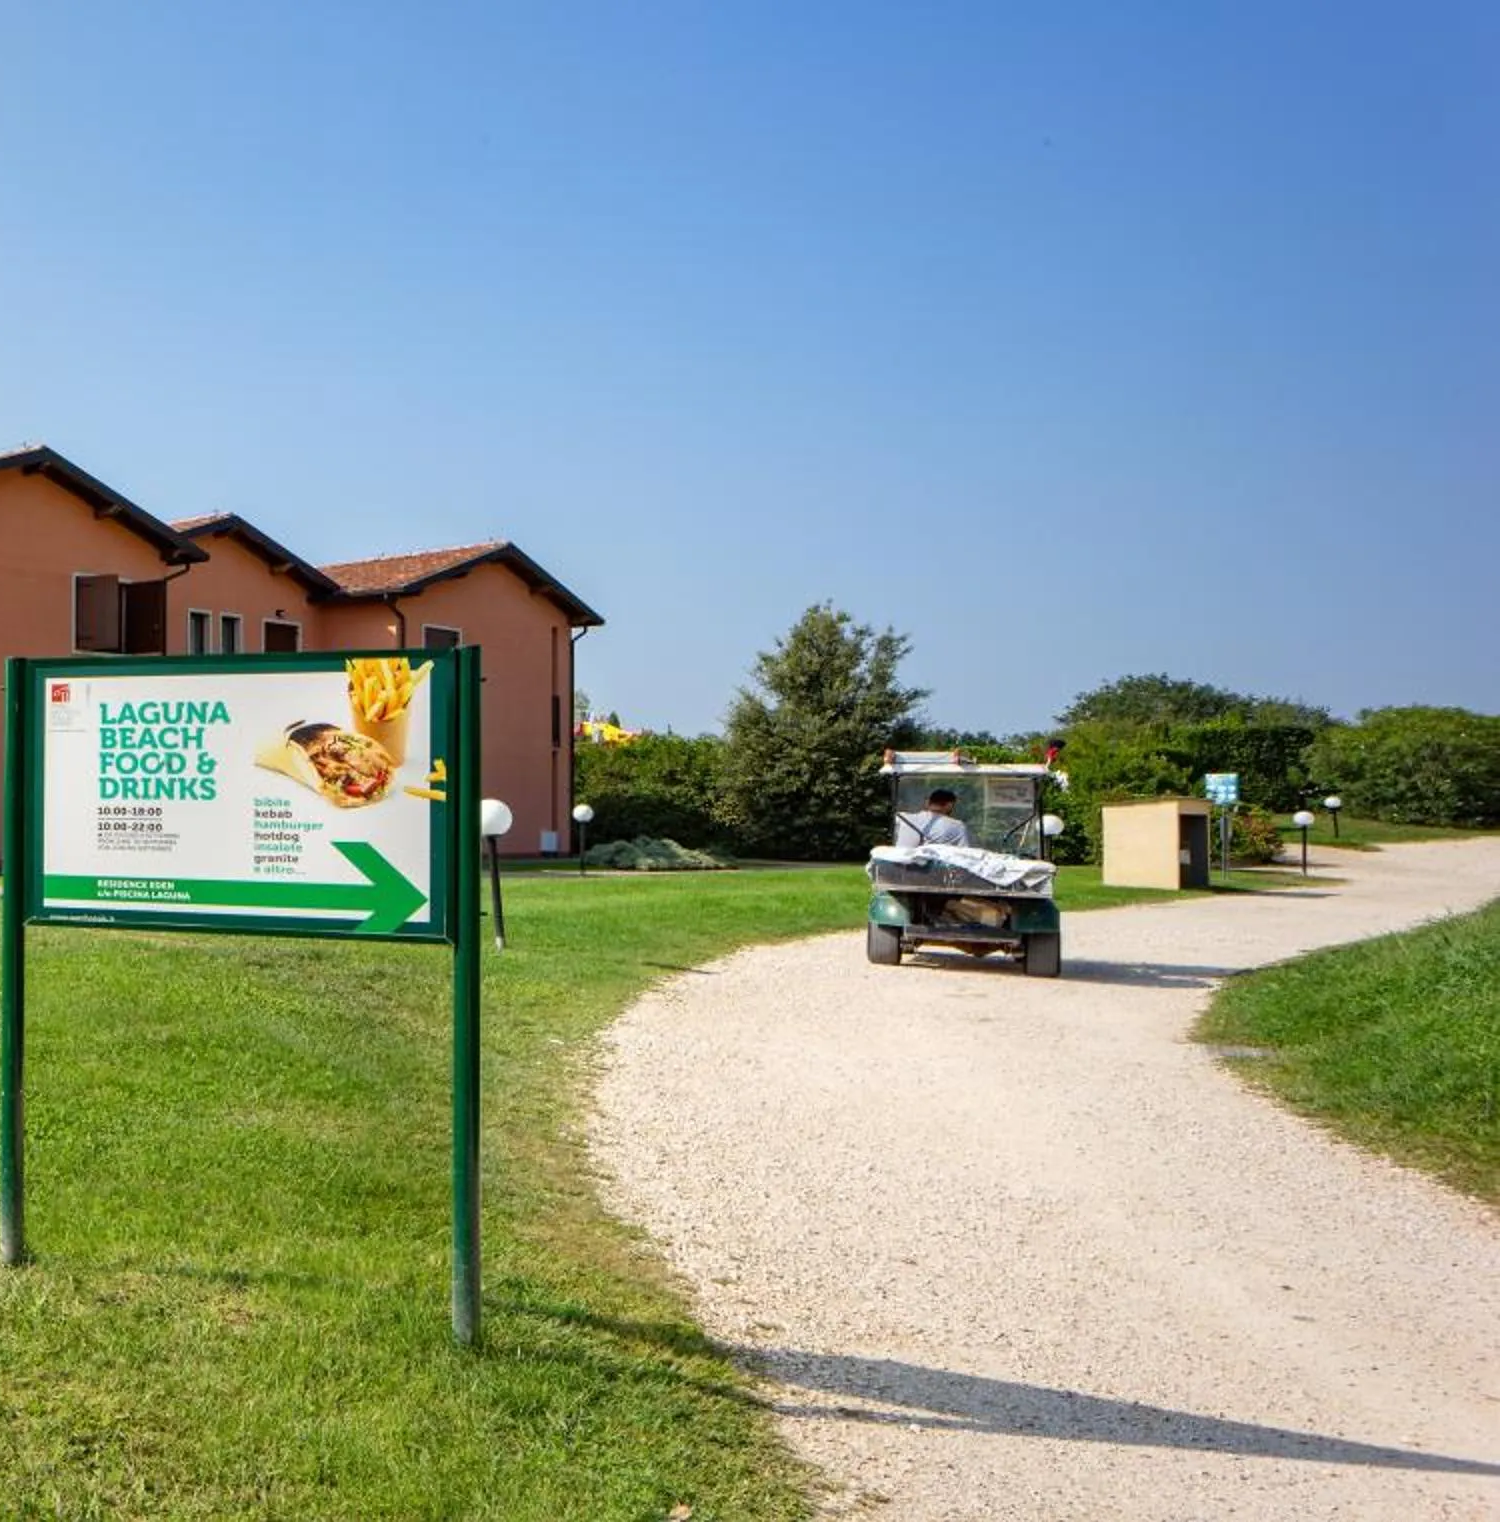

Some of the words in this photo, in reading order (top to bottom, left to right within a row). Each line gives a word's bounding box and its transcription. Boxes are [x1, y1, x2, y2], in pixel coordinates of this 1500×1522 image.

[99, 701, 231, 725] LAGUNA
[99, 727, 205, 749] BEACH
[99, 751, 187, 775] FOOD
[196, 751, 217, 775] &
[99, 776, 217, 801] DRINKS
[254, 808, 293, 819] kebab
[254, 820, 324, 832] hamburger
[254, 831, 300, 843] hotdog
[254, 842, 303, 852] insalate
[254, 854, 299, 865] granite
[97, 879, 147, 889] RESIDENCE
[151, 891, 191, 901] LAGUNA
